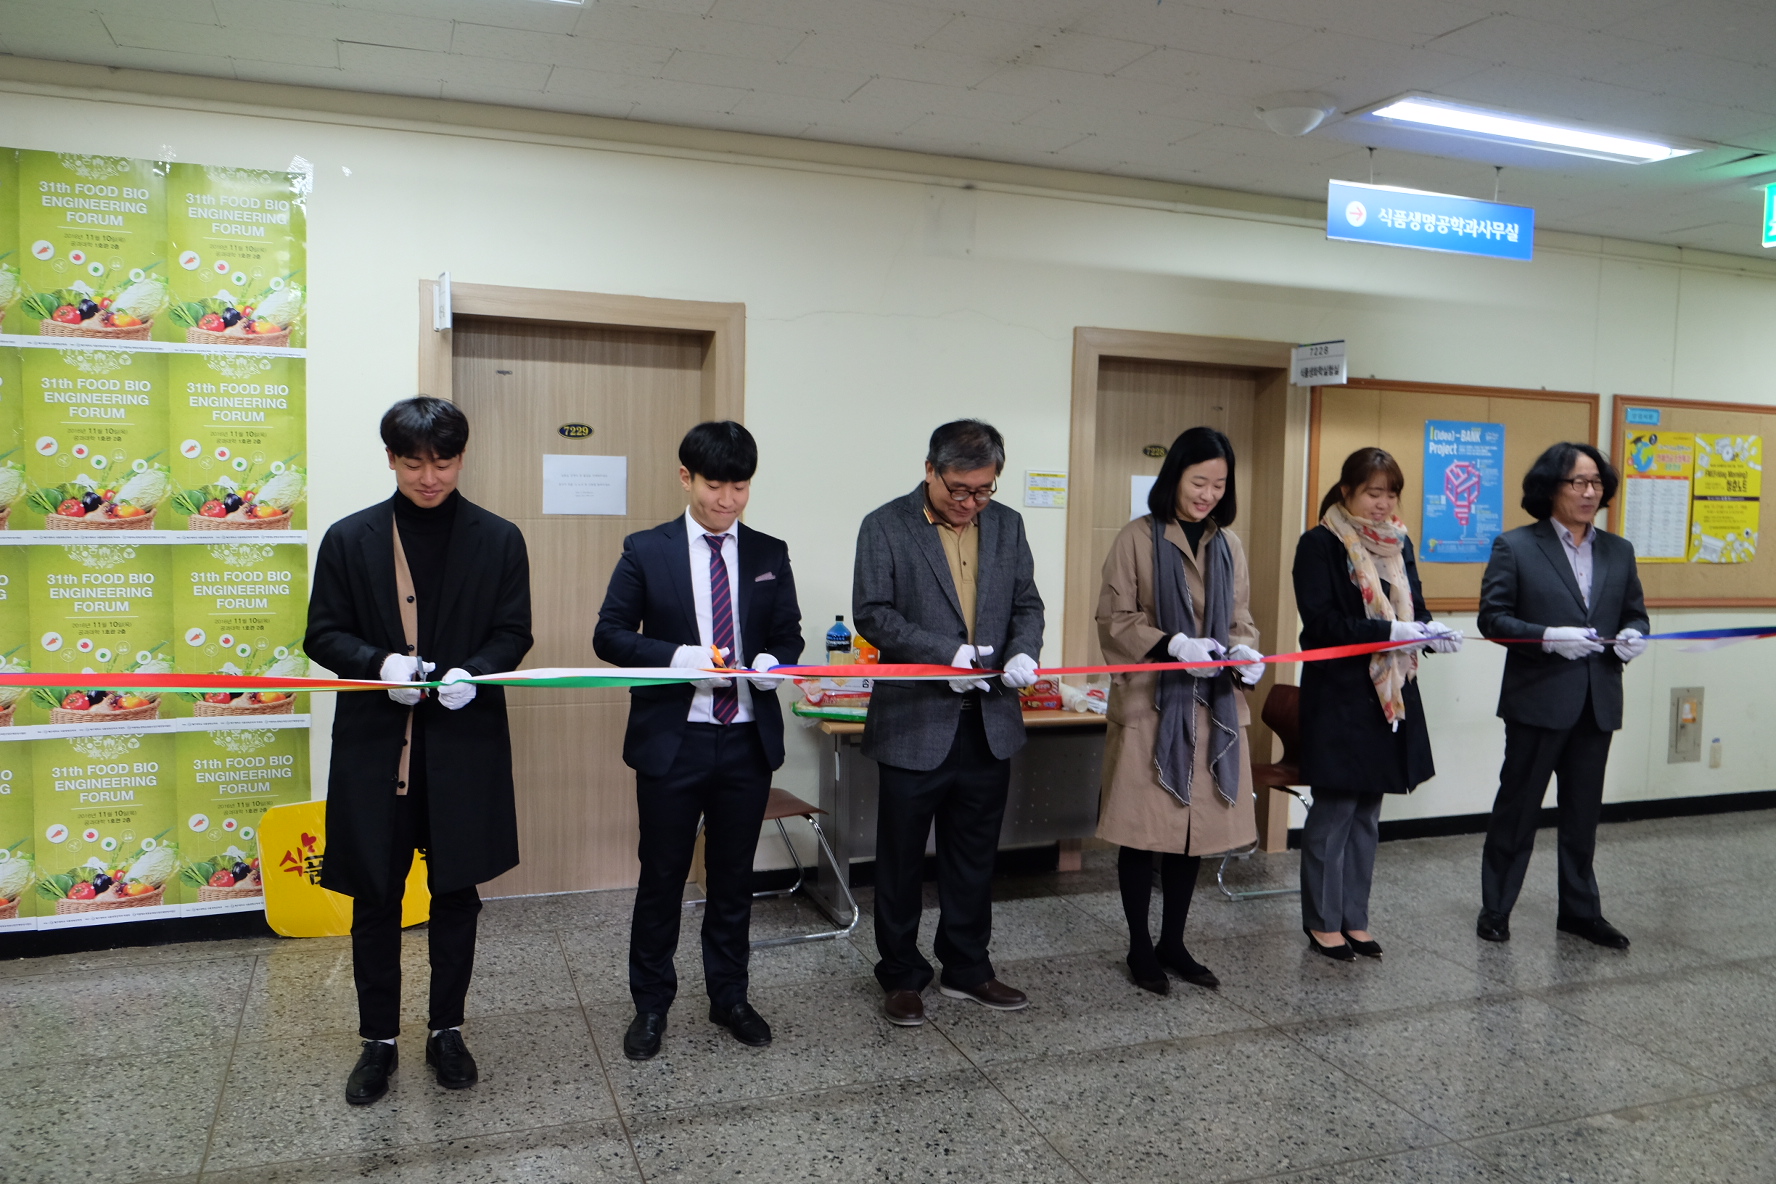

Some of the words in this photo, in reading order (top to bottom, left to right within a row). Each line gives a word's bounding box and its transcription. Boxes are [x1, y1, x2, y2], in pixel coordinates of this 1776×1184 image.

[39, 181, 71, 193] 31th
[75, 183, 119, 197] FOOD
[123, 187, 149, 200] BIO
[42, 195, 148, 214] ENGINEERING
[185, 193, 216, 205] 31th
[220, 195, 261, 209] FOOD
[265, 199, 290, 212] BIO
[66, 211, 124, 226] FORUM
[188, 206, 288, 225] ENGINEERING
[212, 222, 265, 237] FORUM
[1378, 208, 1519, 243] 식품생명공학과사무실
[1310, 346, 1329, 356] 7228
[41, 377, 73, 389] 31th
[77, 378, 121, 390] FOOD
[125, 380, 151, 392] BIO
[186, 382, 216, 393] 31th
[220, 383, 261, 395] FOOD
[264, 384, 289, 396] BIO
[44, 391, 150, 406] ENGINEERING
[189, 396, 288, 409] ENGINEERING
[69, 406, 126, 419] FORUM
[212, 410, 265, 422] FORUM
[563, 426, 589, 436] 7229
[1429, 441, 1457, 457] Project
[47, 574, 78, 585] 31th
[82, 573, 125, 585] FOOD
[129, 573, 155, 584] BIO
[190, 572, 220, 582] 31th
[223, 571, 264, 582] FOOD
[267, 571, 292, 581] BIO
[49, 587, 153, 599] ENGINEERING
[193, 584, 290, 596] ENGINEERING
[74, 601, 130, 612] FORUM
[216, 598, 268, 609] FORUM
[193, 759, 222, 770] 31th
[226, 757, 265, 768] FOOD
[269, 755, 293, 766] BIO
[51, 766, 83, 778] 31th
[87, 763, 130, 776] FOOD
[133, 762, 159, 773] BIO
[196, 768, 292, 783] ENGINEERING
[55, 775, 157, 791] ENGINEERING
[219, 782, 270, 795] FORUM
[79, 790, 135, 803] FORUM
